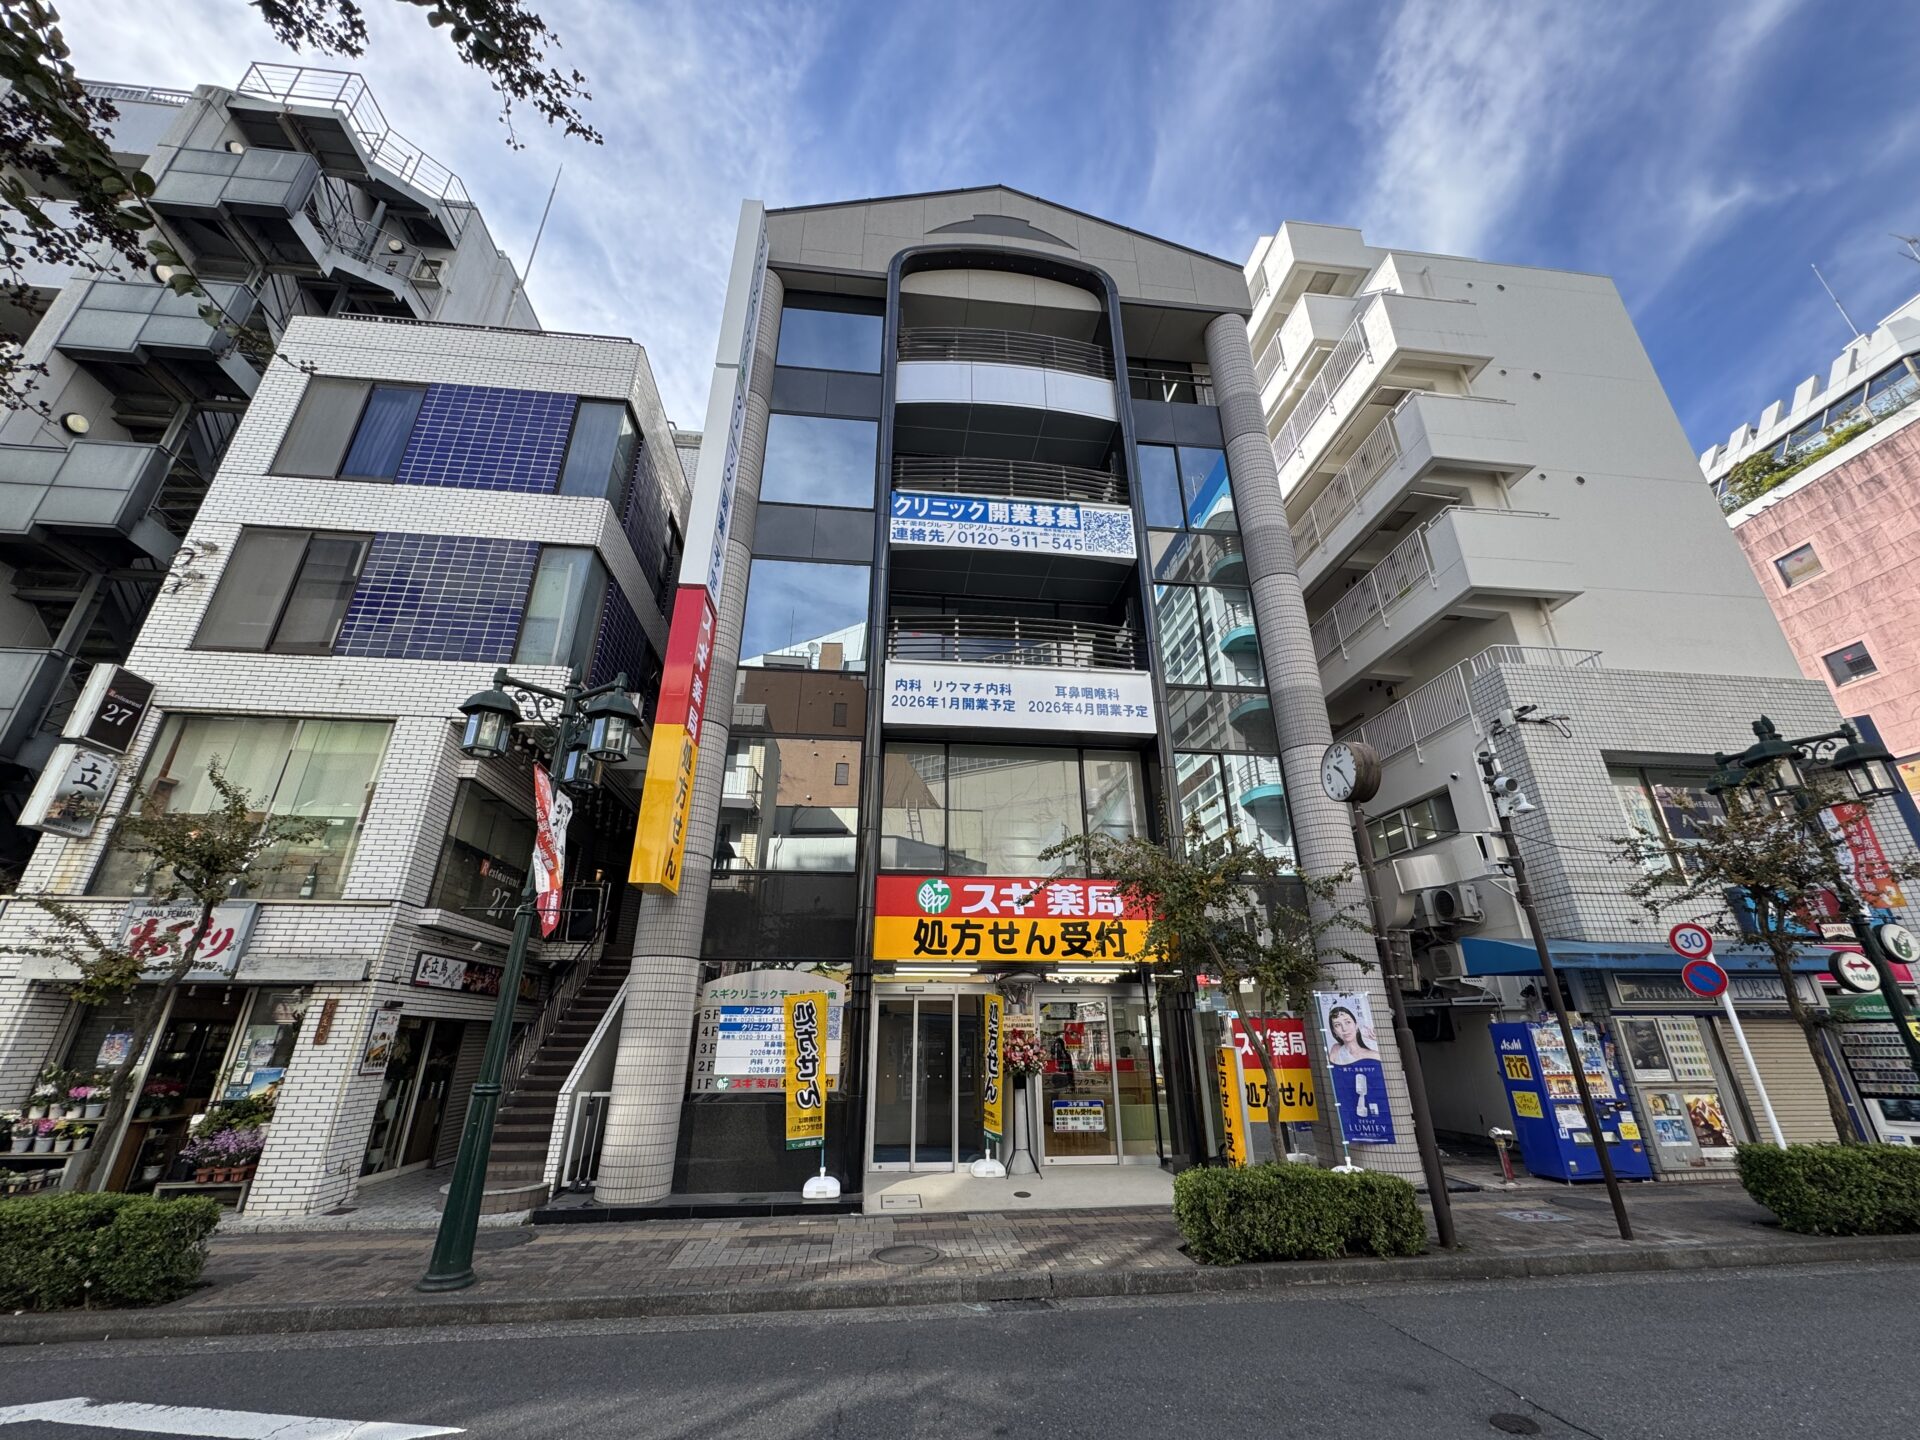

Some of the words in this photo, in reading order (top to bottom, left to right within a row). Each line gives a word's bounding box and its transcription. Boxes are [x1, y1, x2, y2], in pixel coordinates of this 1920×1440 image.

[893, 496, 1081, 529] クリニック開業募集
[957, 523, 1020, 533] DCPソリューション
[892, 528, 1083, 551] 連絡先/0120-911-545
[686, 606, 712, 740] スギ薬局
[895, 679, 921, 692] 内科
[932, 680, 1012, 696] リウマチ内科
[1054, 685, 1120, 701] 耳鼻咽喉科
[891, 696, 1016, 713] 2026年1月開業予定
[1028, 700, 1149, 718] 2026年4月開業予定
[101, 703, 134, 726] 27
[1334, 746, 1342, 758] 12
[1326, 773, 1332, 784] 9
[1342, 787, 1349, 797] 6
[664, 739, 693, 882] 処方せん
[480, 858, 521, 888] Restaurant
[486, 888, 511, 919] 27
[961, 880, 1124, 916] スギ薬局
[141, 910, 163, 918] HANA
[913, 919, 1127, 957] 処方せん受付
[1679, 932, 1704, 950] 30
[710, 989, 837, 999] スギクリニックモール南
[1634, 986, 1700, 999] AKIYAM
[1731, 978, 1803, 998] TOBACO
[704, 1010, 720, 1020] 5F
[702, 1026, 718, 1036] 4F
[700, 1043, 716, 1054] 3F
[1501, 1038, 1521, 1050] Asahi
[985, 1002, 999, 1104] 処方せん
[698, 1061, 714, 1071] 2F
[1506, 1062, 1530, 1079] 110
[697, 1079, 713, 1089] 1F
[731, 1078, 779, 1088] スギ薬局
[1349, 1124, 1387, 1133] LUMIFY
